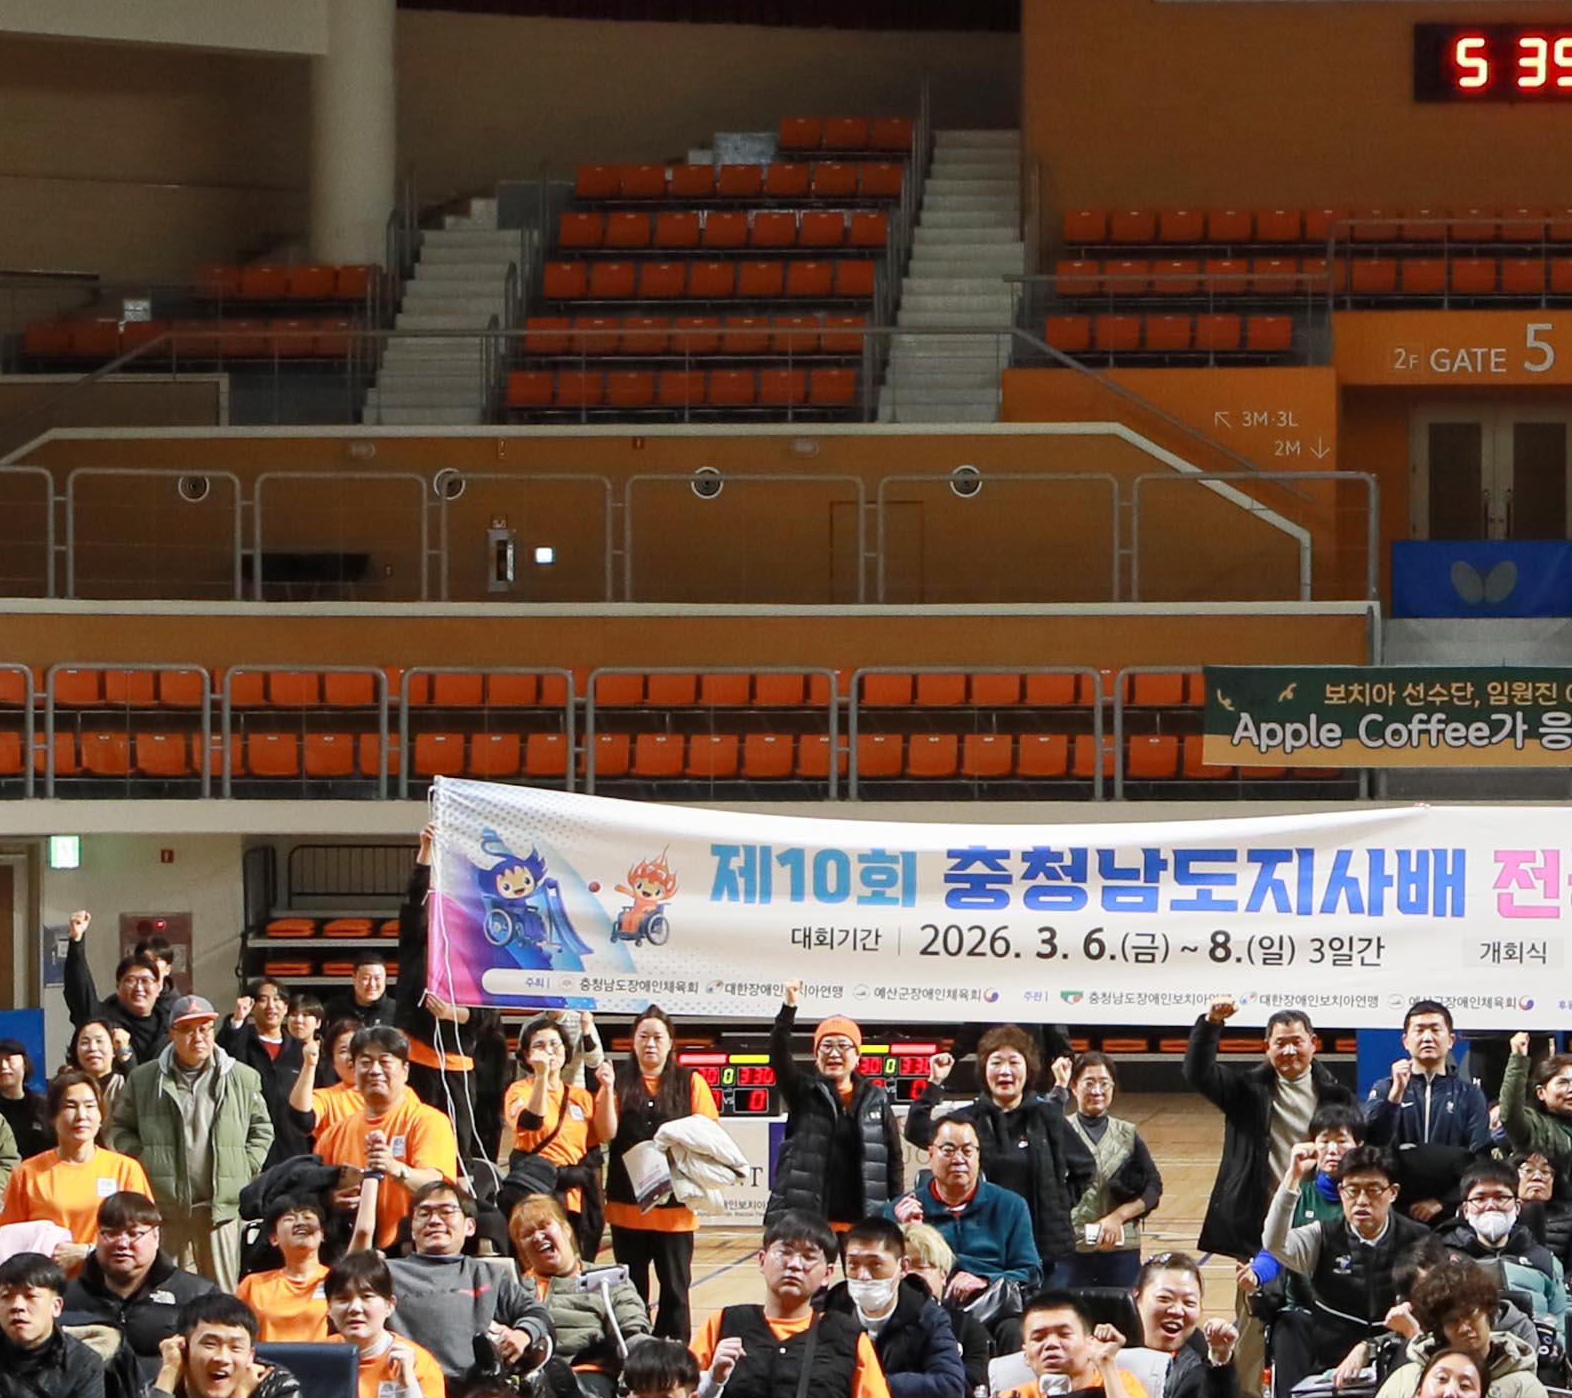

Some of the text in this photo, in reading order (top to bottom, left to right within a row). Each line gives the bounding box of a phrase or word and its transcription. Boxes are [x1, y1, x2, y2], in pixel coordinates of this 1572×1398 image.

[1392, 322, 1556, 374] 2F GATE 5
[1273, 440, 1302, 457] 2M
[1324, 682, 1396, 706] 보치아
[1402, 682, 1480, 708] 선수단,
[1486, 682, 1559, 706] 임원진
[1231, 713, 1342, 754] Apple
[1357, 711, 1528, 749] Coffee가
[709, 843, 918, 908] 제10회
[943, 845, 1467, 918] 충청남도지사배
[790, 925, 882, 954] 대회기간
[919, 923, 1023, 961] 2026.
[1035, 925, 1072, 961] 3.
[1081, 929, 1172, 968] 6.(금)
[1208, 929, 1297, 969] 8.(일)
[1308, 935, 1386, 968] 3일간
[1479, 939, 1548, 967] 개회식
[579, 979, 699, 994] 충청남도장애인체육회
[724, 982, 844, 999] 대한장애인아연맹
[874, 986, 982, 1002] 예산군장애인체육회
[1259, 994, 1379, 1009] 대한장애인보치아연맹
